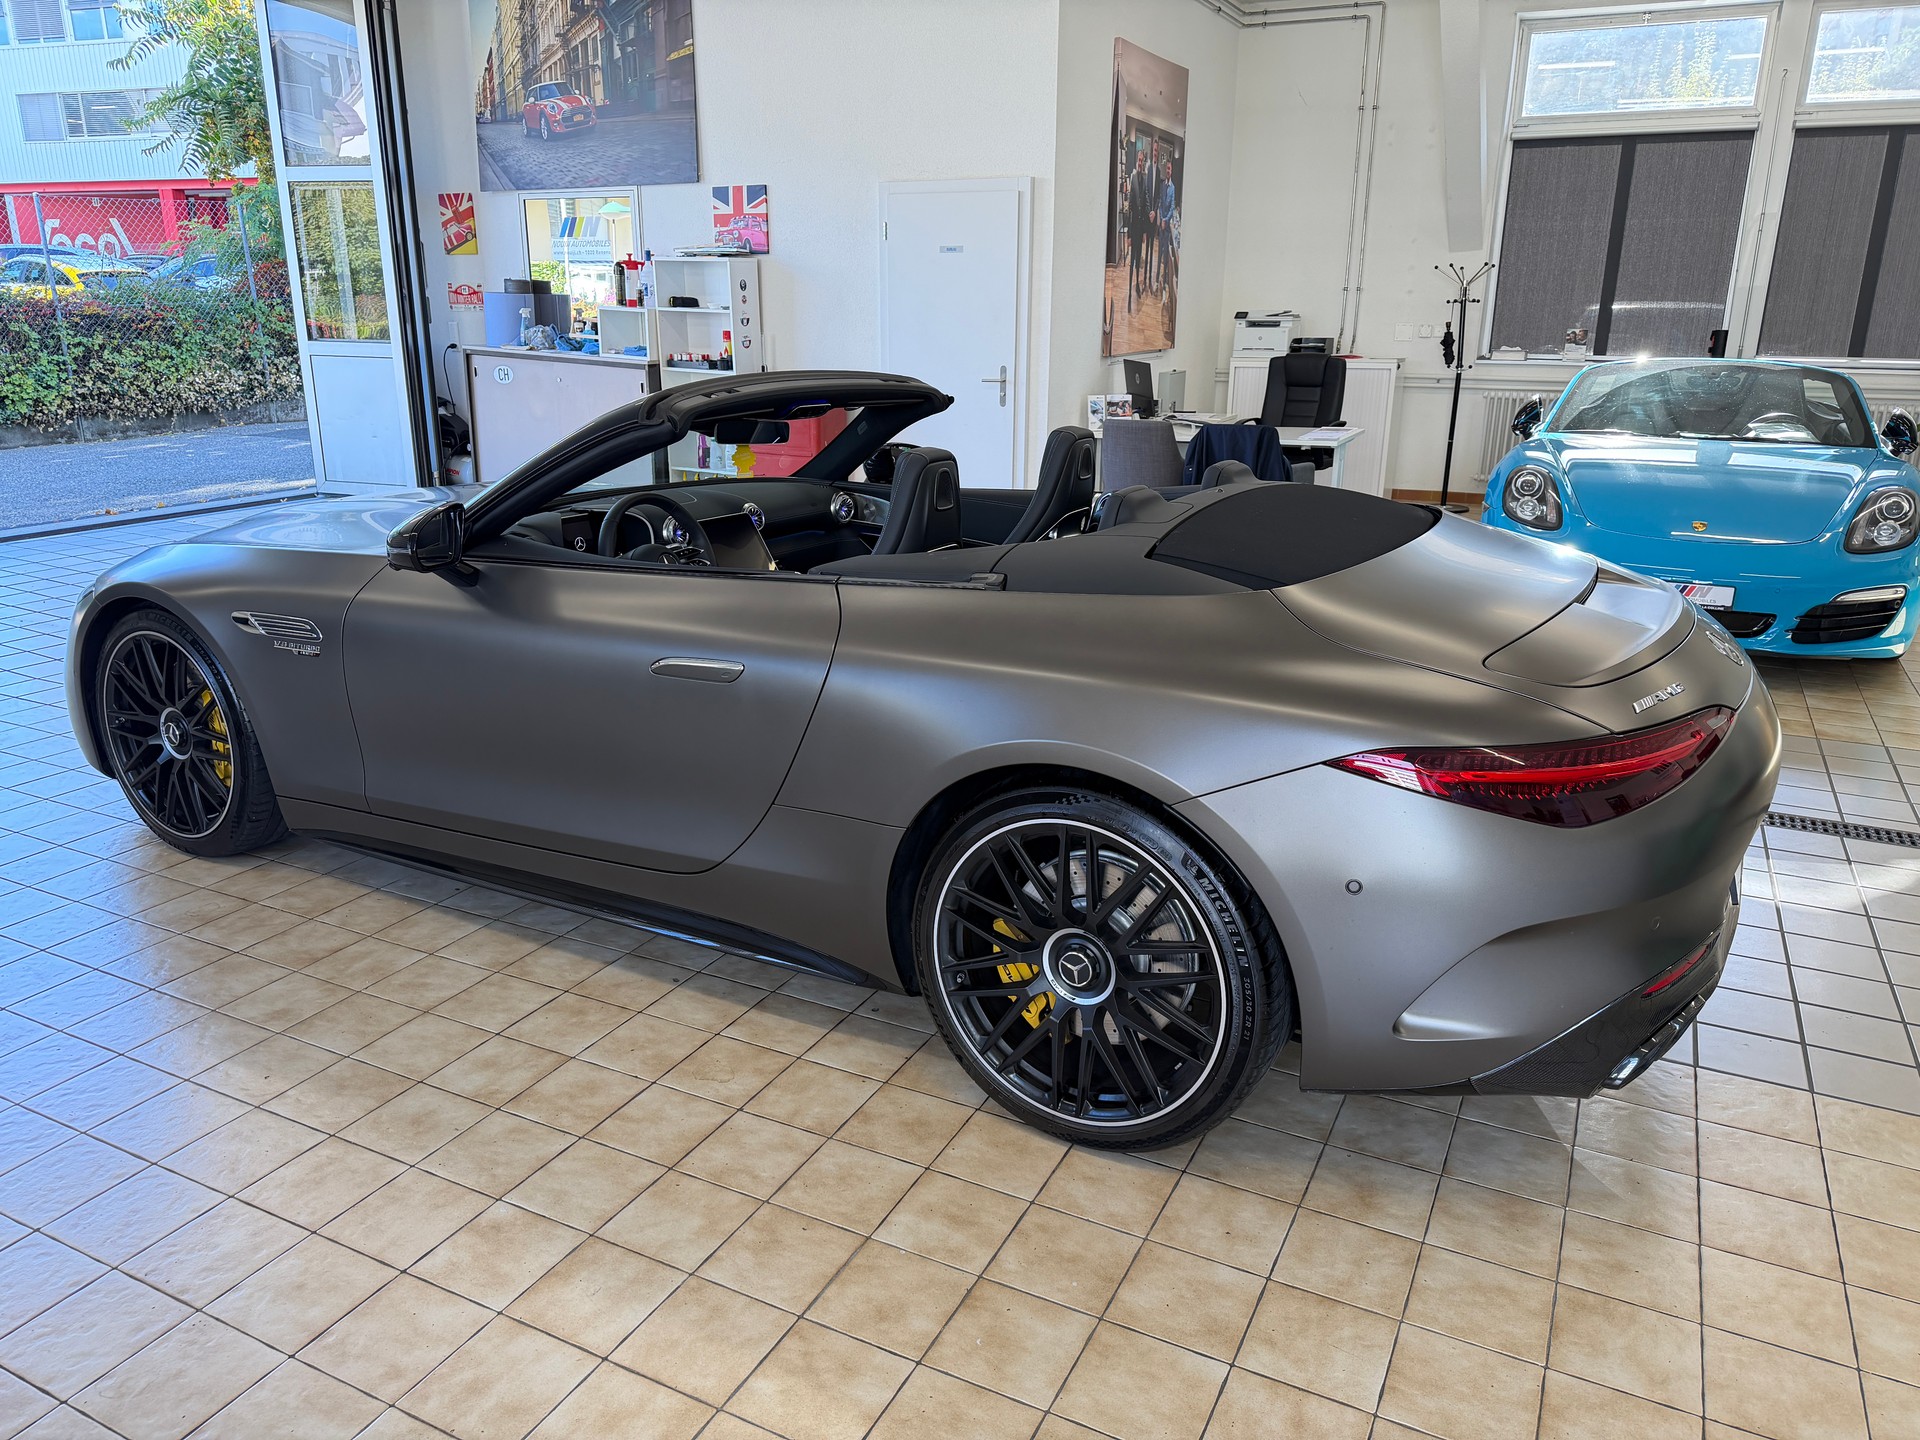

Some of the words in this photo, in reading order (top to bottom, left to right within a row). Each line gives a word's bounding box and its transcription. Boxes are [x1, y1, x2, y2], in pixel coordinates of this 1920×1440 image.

[570, 240, 611, 248] AUTOMOBILES
[497, 367, 510, 381] CH
[1198, 877, 1249, 967] MICHELIN
[1243, 977, 1253, 1013] 305/30
[1245, 1015, 1252, 1028] ZR
[1243, 1030, 1251, 1041] 21
